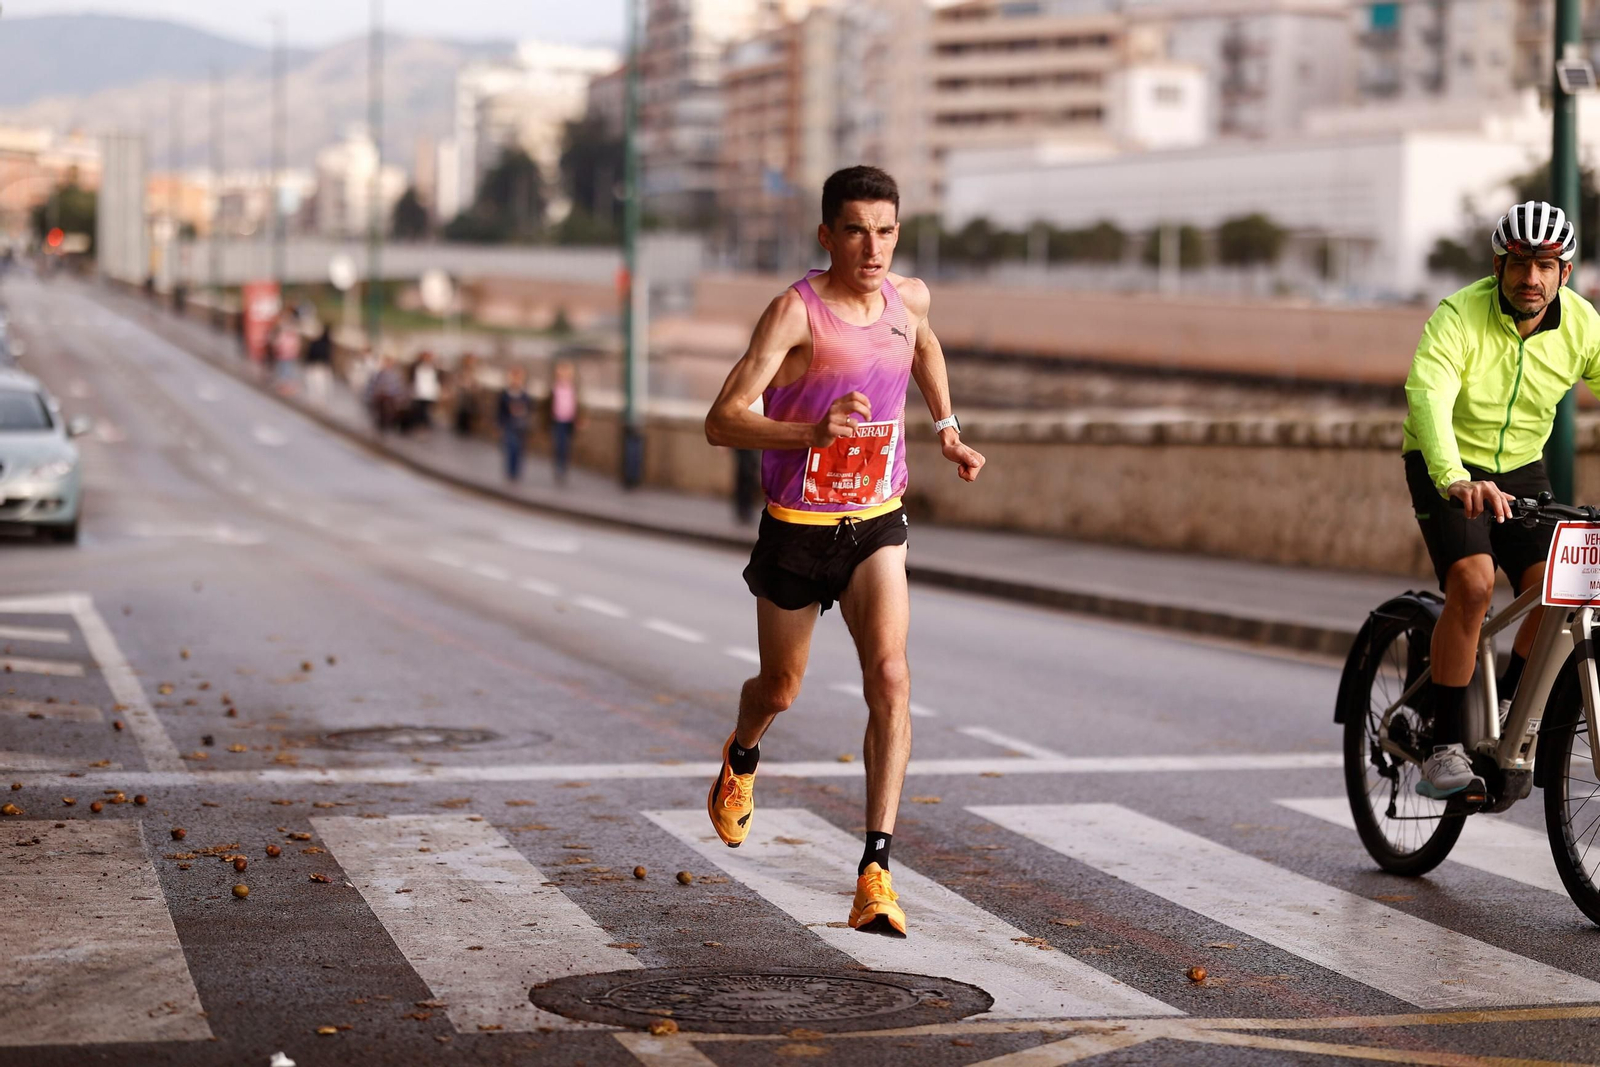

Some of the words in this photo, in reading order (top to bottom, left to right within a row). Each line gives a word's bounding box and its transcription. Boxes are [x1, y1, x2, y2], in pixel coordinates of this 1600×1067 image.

[838, 425, 889, 438] NERALI
[848, 446, 860, 456] 26
[1585, 533, 1600, 545] VEH
[1560, 545, 1600, 565] AUTO
